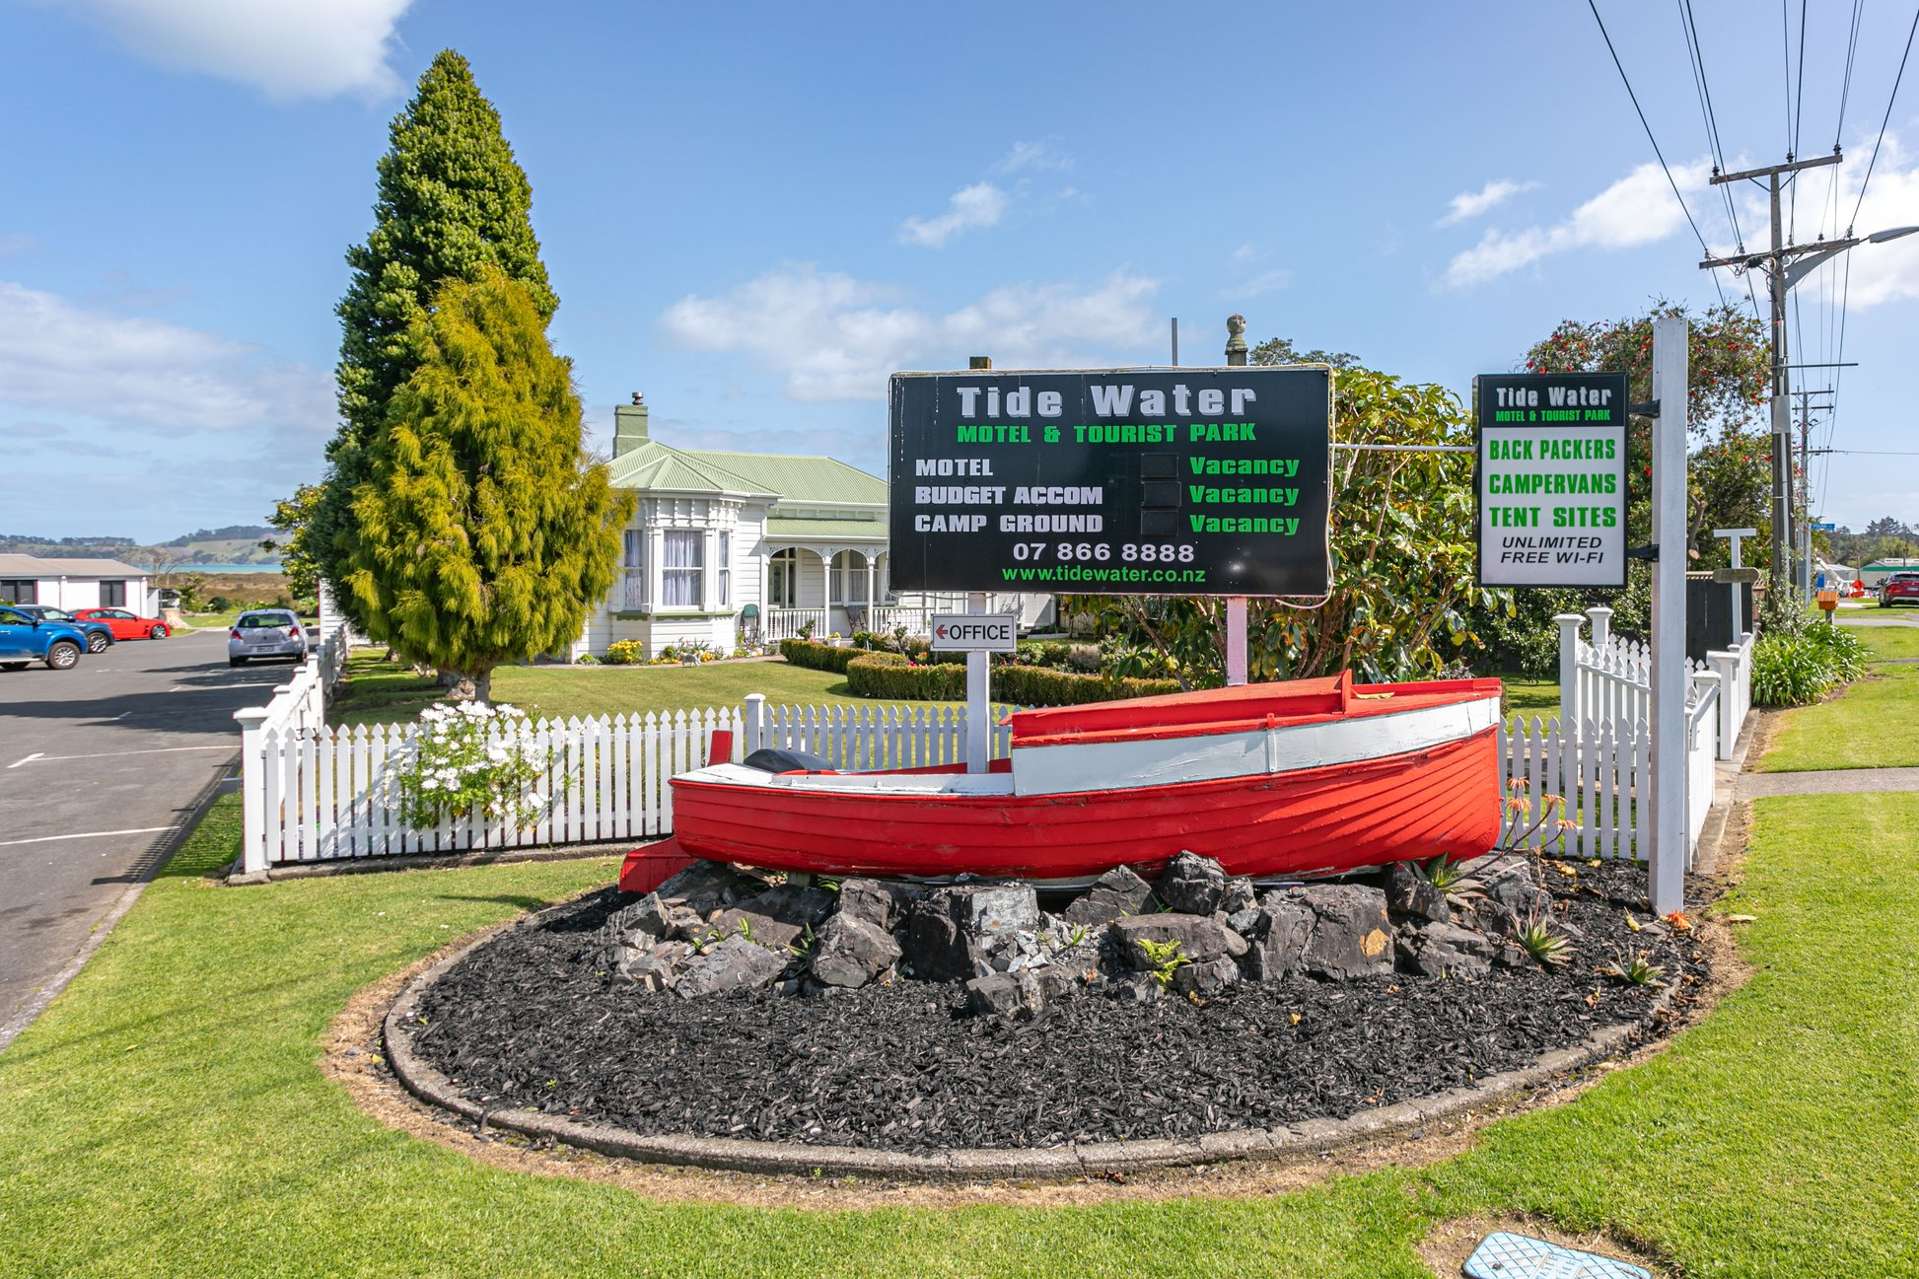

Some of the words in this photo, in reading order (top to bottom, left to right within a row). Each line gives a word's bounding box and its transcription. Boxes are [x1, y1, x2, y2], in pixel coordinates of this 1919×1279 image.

[956, 386, 1063, 418] Tide
[1090, 385, 1257, 417] Water
[1496, 387, 1538, 407] Tide
[1548, 386, 1612, 407] Water
[1495, 411, 1525, 422] MOTEL
[1529, 411, 1537, 422] &
[1541, 410, 1580, 422] TOURIST
[1584, 409, 1611, 421] PARK
[957, 425, 1031, 443] MOTEL
[1043, 425, 1060, 443] &
[1074, 424, 1177, 443] TOURIST
[1189, 423, 1256, 441] PARK
[1489, 439, 1533, 461] BACK
[1540, 439, 1616, 460] PACKERS
[915, 458, 994, 477] MOTEL
[1189, 456, 1300, 479] Vacancy
[1489, 473, 1617, 495] CAMPERVANS
[915, 486, 1007, 505] BUDGET
[1013, 486, 1103, 505] ACCOM
[1189, 485, 1300, 507] Vacancy
[915, 514, 987, 533] CAMP
[999, 514, 1103, 533] GROUND
[1189, 515, 1300, 537] Vacancy
[1489, 507, 1541, 528] TENT
[1552, 506, 1617, 528] SITES
[1013, 542, 1046, 561] 07
[1057, 542, 1111, 561] 866
[1121, 543, 1195, 562] 8888
[1502, 536, 1602, 549] UNLIMITED
[1500, 551, 1550, 564] FREE
[1556, 551, 1604, 564] WI-FI
[1002, 565, 1206, 583] www.tidewater.co.nz
[949, 624, 1010, 640] OFFICE
